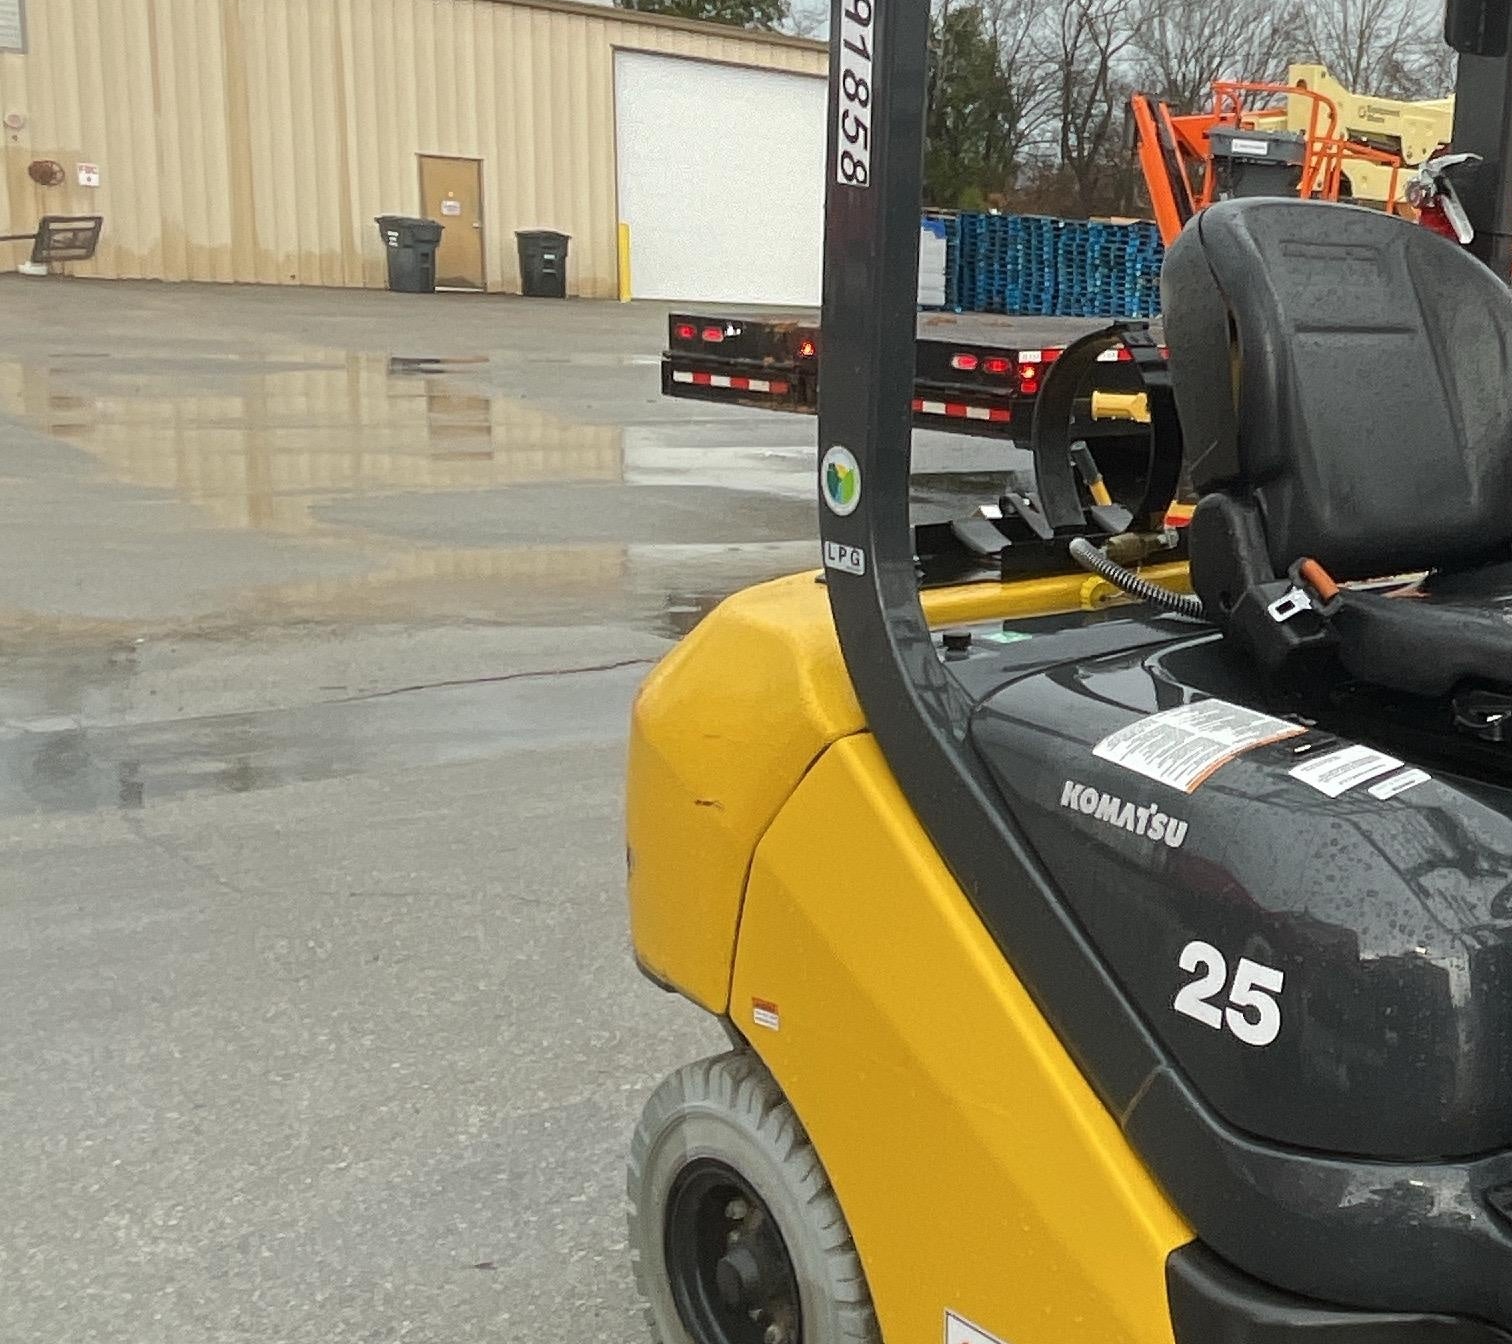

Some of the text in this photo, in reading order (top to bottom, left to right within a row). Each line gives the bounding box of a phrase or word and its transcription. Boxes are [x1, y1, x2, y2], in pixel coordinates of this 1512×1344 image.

[826, 542, 861, 567] LPG
[1060, 779, 1189, 848] KOMATSU
[1173, 940, 1284, 1046] 25
